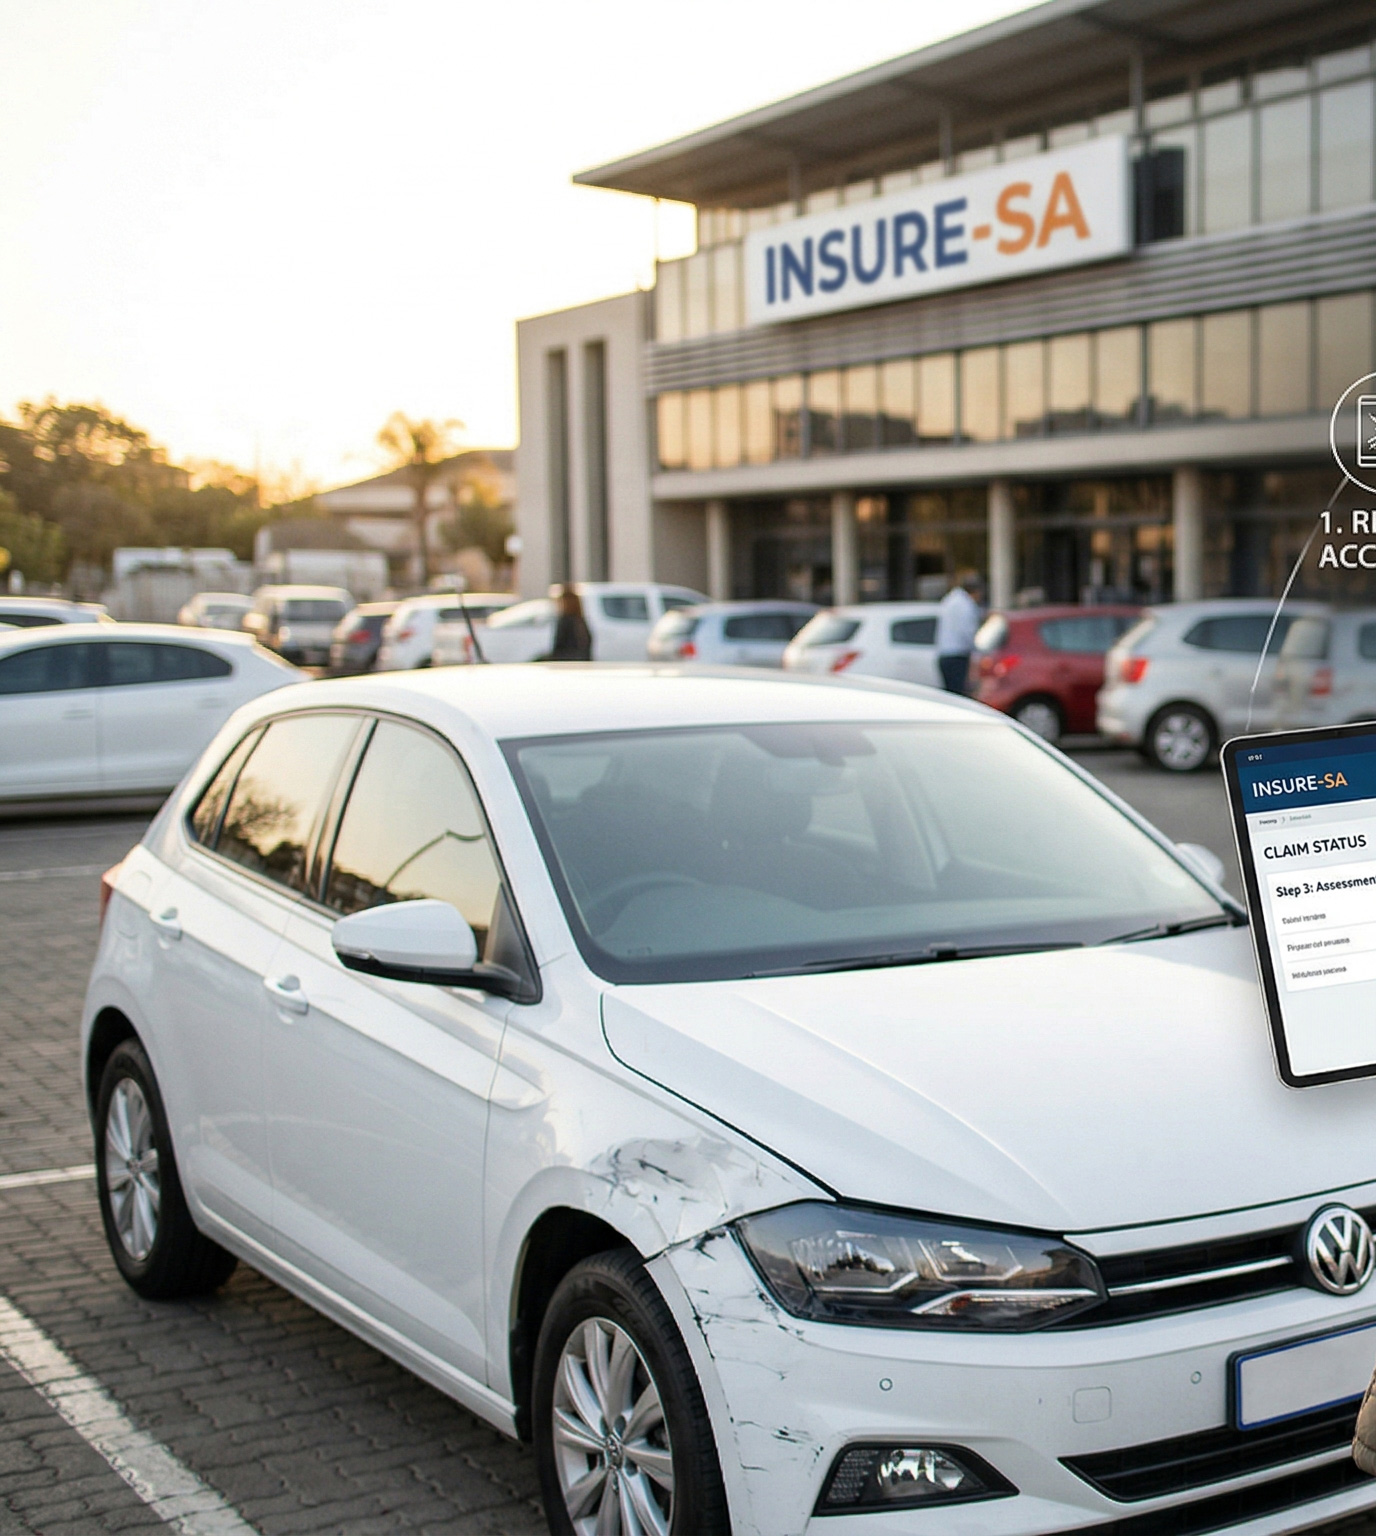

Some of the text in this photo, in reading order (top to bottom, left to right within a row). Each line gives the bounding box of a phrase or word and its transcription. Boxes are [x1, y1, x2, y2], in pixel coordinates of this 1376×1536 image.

[765, 170, 1091, 305] INSURE-SA
[1252, 772, 1348, 798] INSURE-SA
[1264, 834, 1367, 860] CLAIM STATUS
[1303, 883, 1314, 894] 3:
